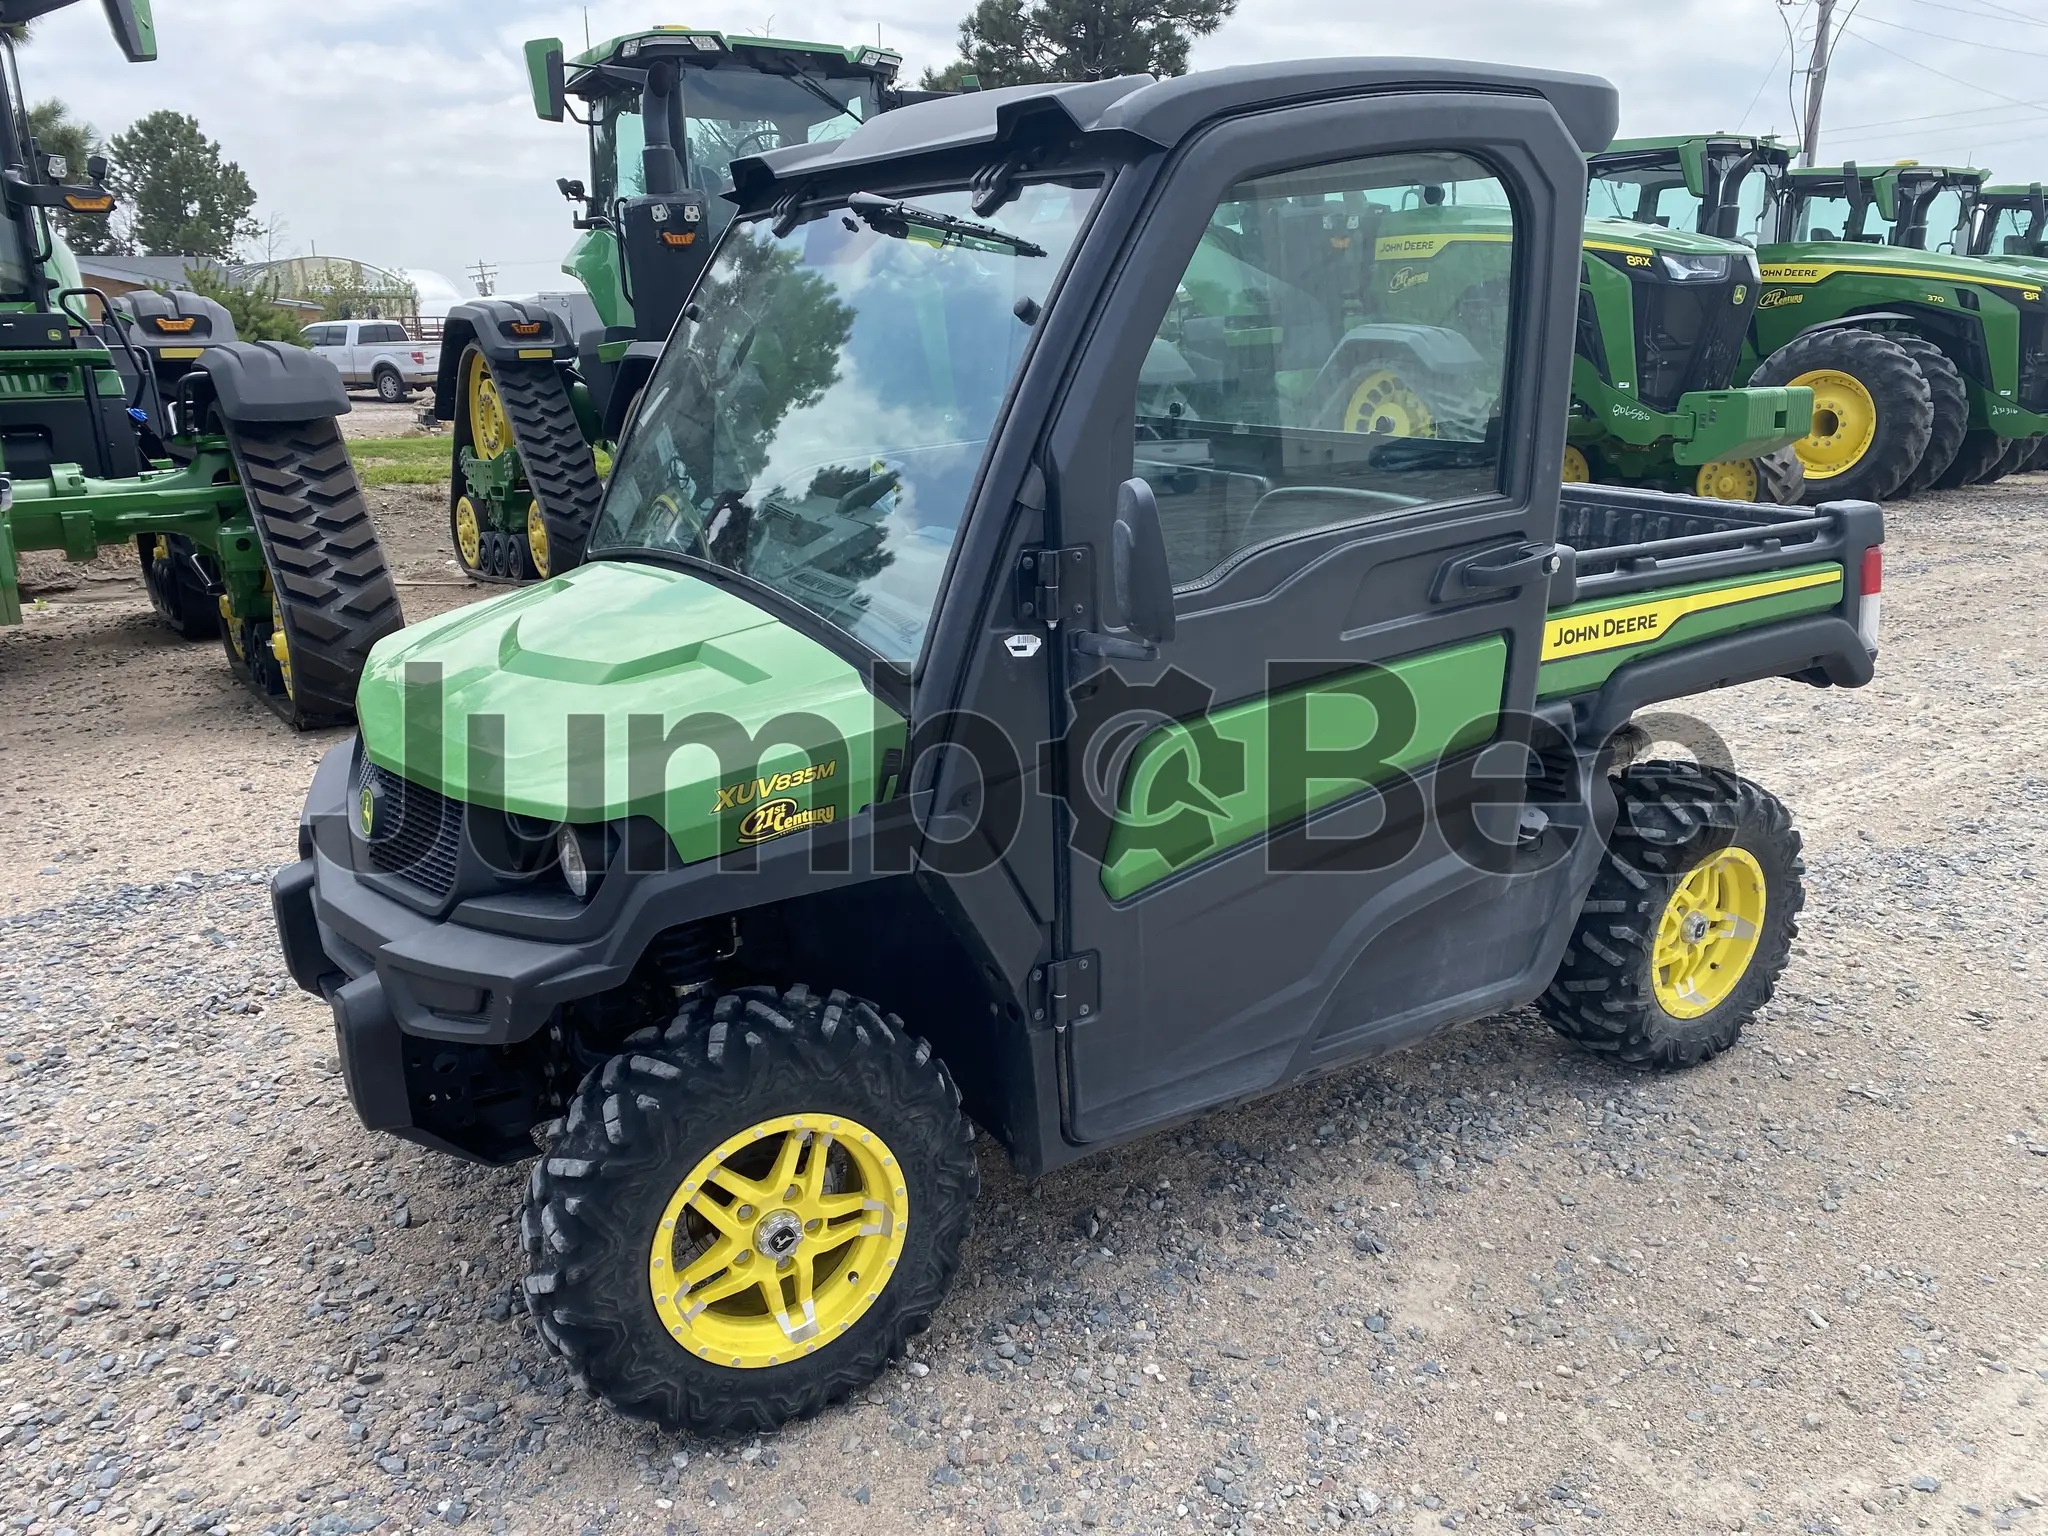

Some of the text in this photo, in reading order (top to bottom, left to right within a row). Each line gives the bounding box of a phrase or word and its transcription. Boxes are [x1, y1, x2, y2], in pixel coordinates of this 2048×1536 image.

[1380, 240, 1434, 253] JOHN DEERE
[1626, 254, 1652, 267] 8RX
[1783, 268, 1818, 277] DEERE
[1927, 294, 1945, 303] 370
[2023, 291, 2040, 301] 8R
[1553, 613, 1657, 647] JOHN DEERE
[709, 760, 837, 815] XUV835M
[751, 802, 787, 833] 21st
